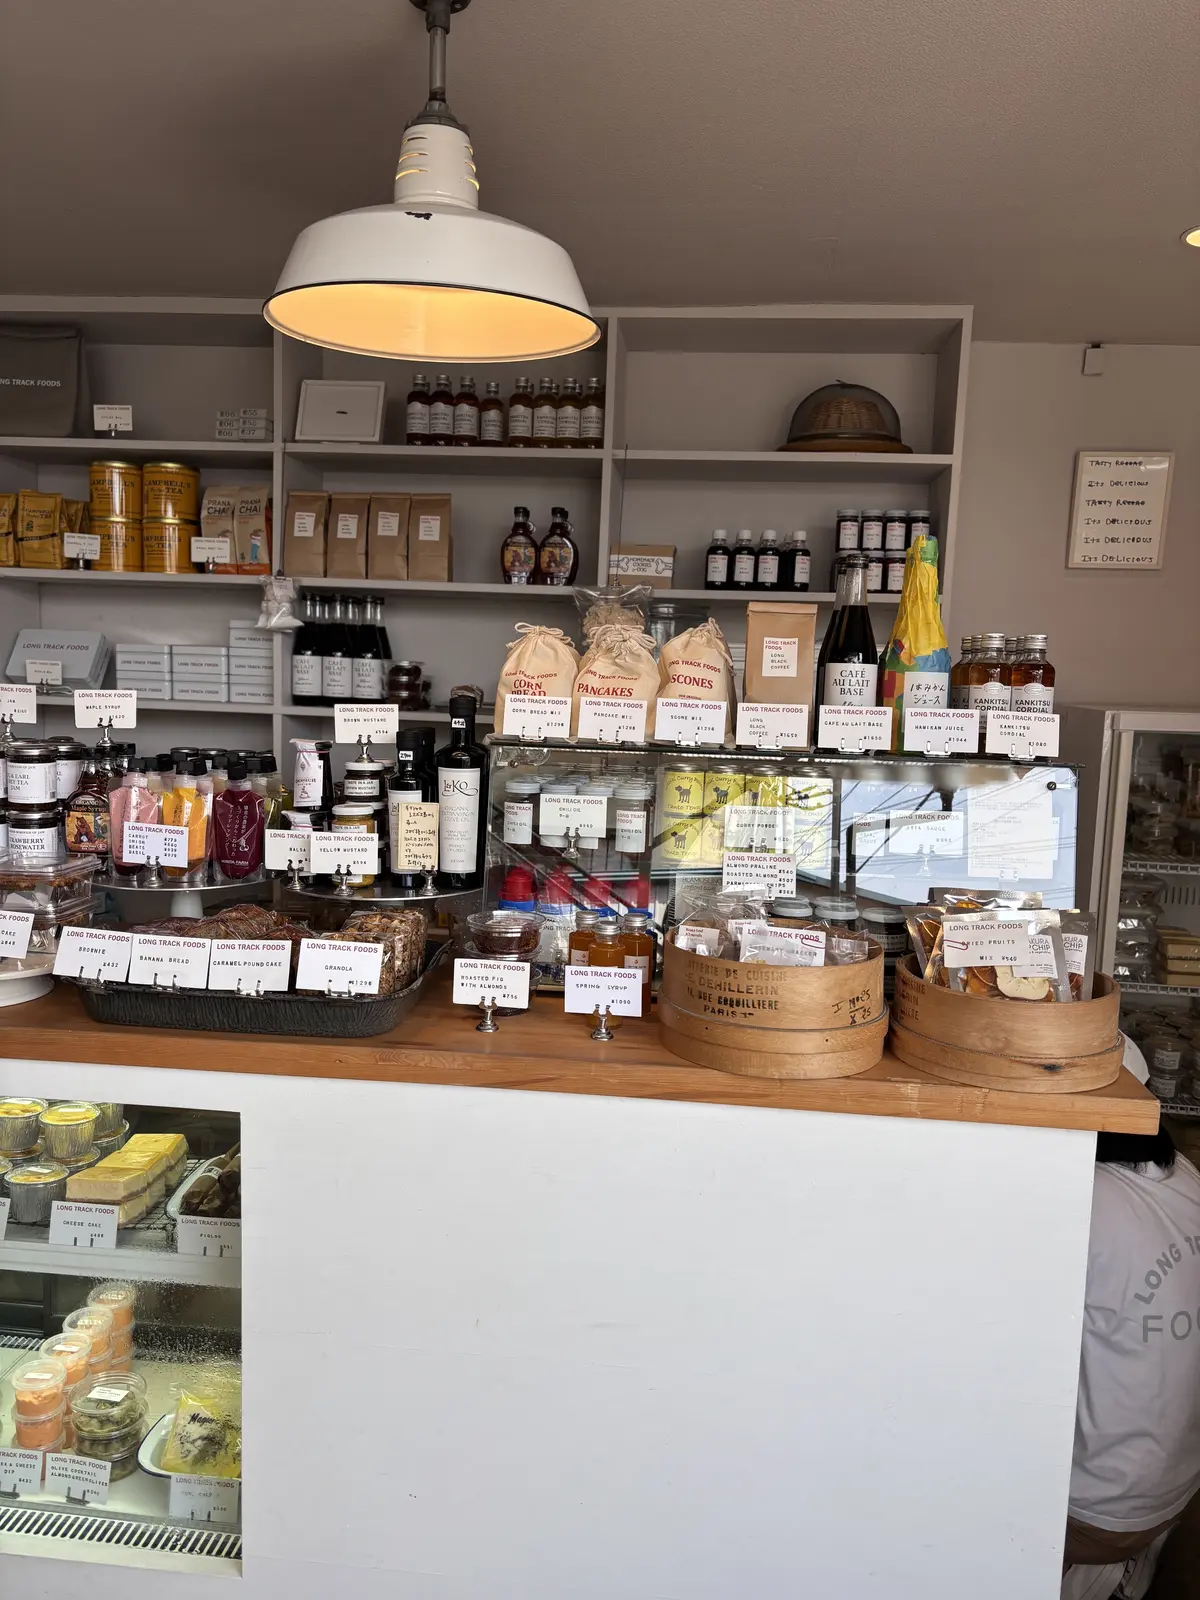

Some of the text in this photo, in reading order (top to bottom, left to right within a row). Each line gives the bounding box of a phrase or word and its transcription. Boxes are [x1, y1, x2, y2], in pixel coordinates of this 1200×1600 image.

[681, 660, 721, 673] TRACK FOODS
[840, 668, 866, 678] CAFÉ
[514, 679, 542, 690] CORN
[671, 674, 714, 690] SCONES
[832, 679, 871, 688] AU LAIT
[577, 682, 633, 697] PANCAKES
[840, 687, 864, 696] BASE
[914, 694, 940, 705] ジュース
[108, 934, 130, 943] FOODS
[138, 938, 206, 949] LONG TRACK FOODS
[306, 943, 378, 954] LONG TRACK FOODS
[699, 978, 779, 996] DEHILLERIN
[704, 1004, 736, 1017] PARIS
[1134, 1243, 1182, 1305] LONG
[88, 1462, 107, 1470] FOODS
[70, 1468, 97, 1477] COCKTAIL
